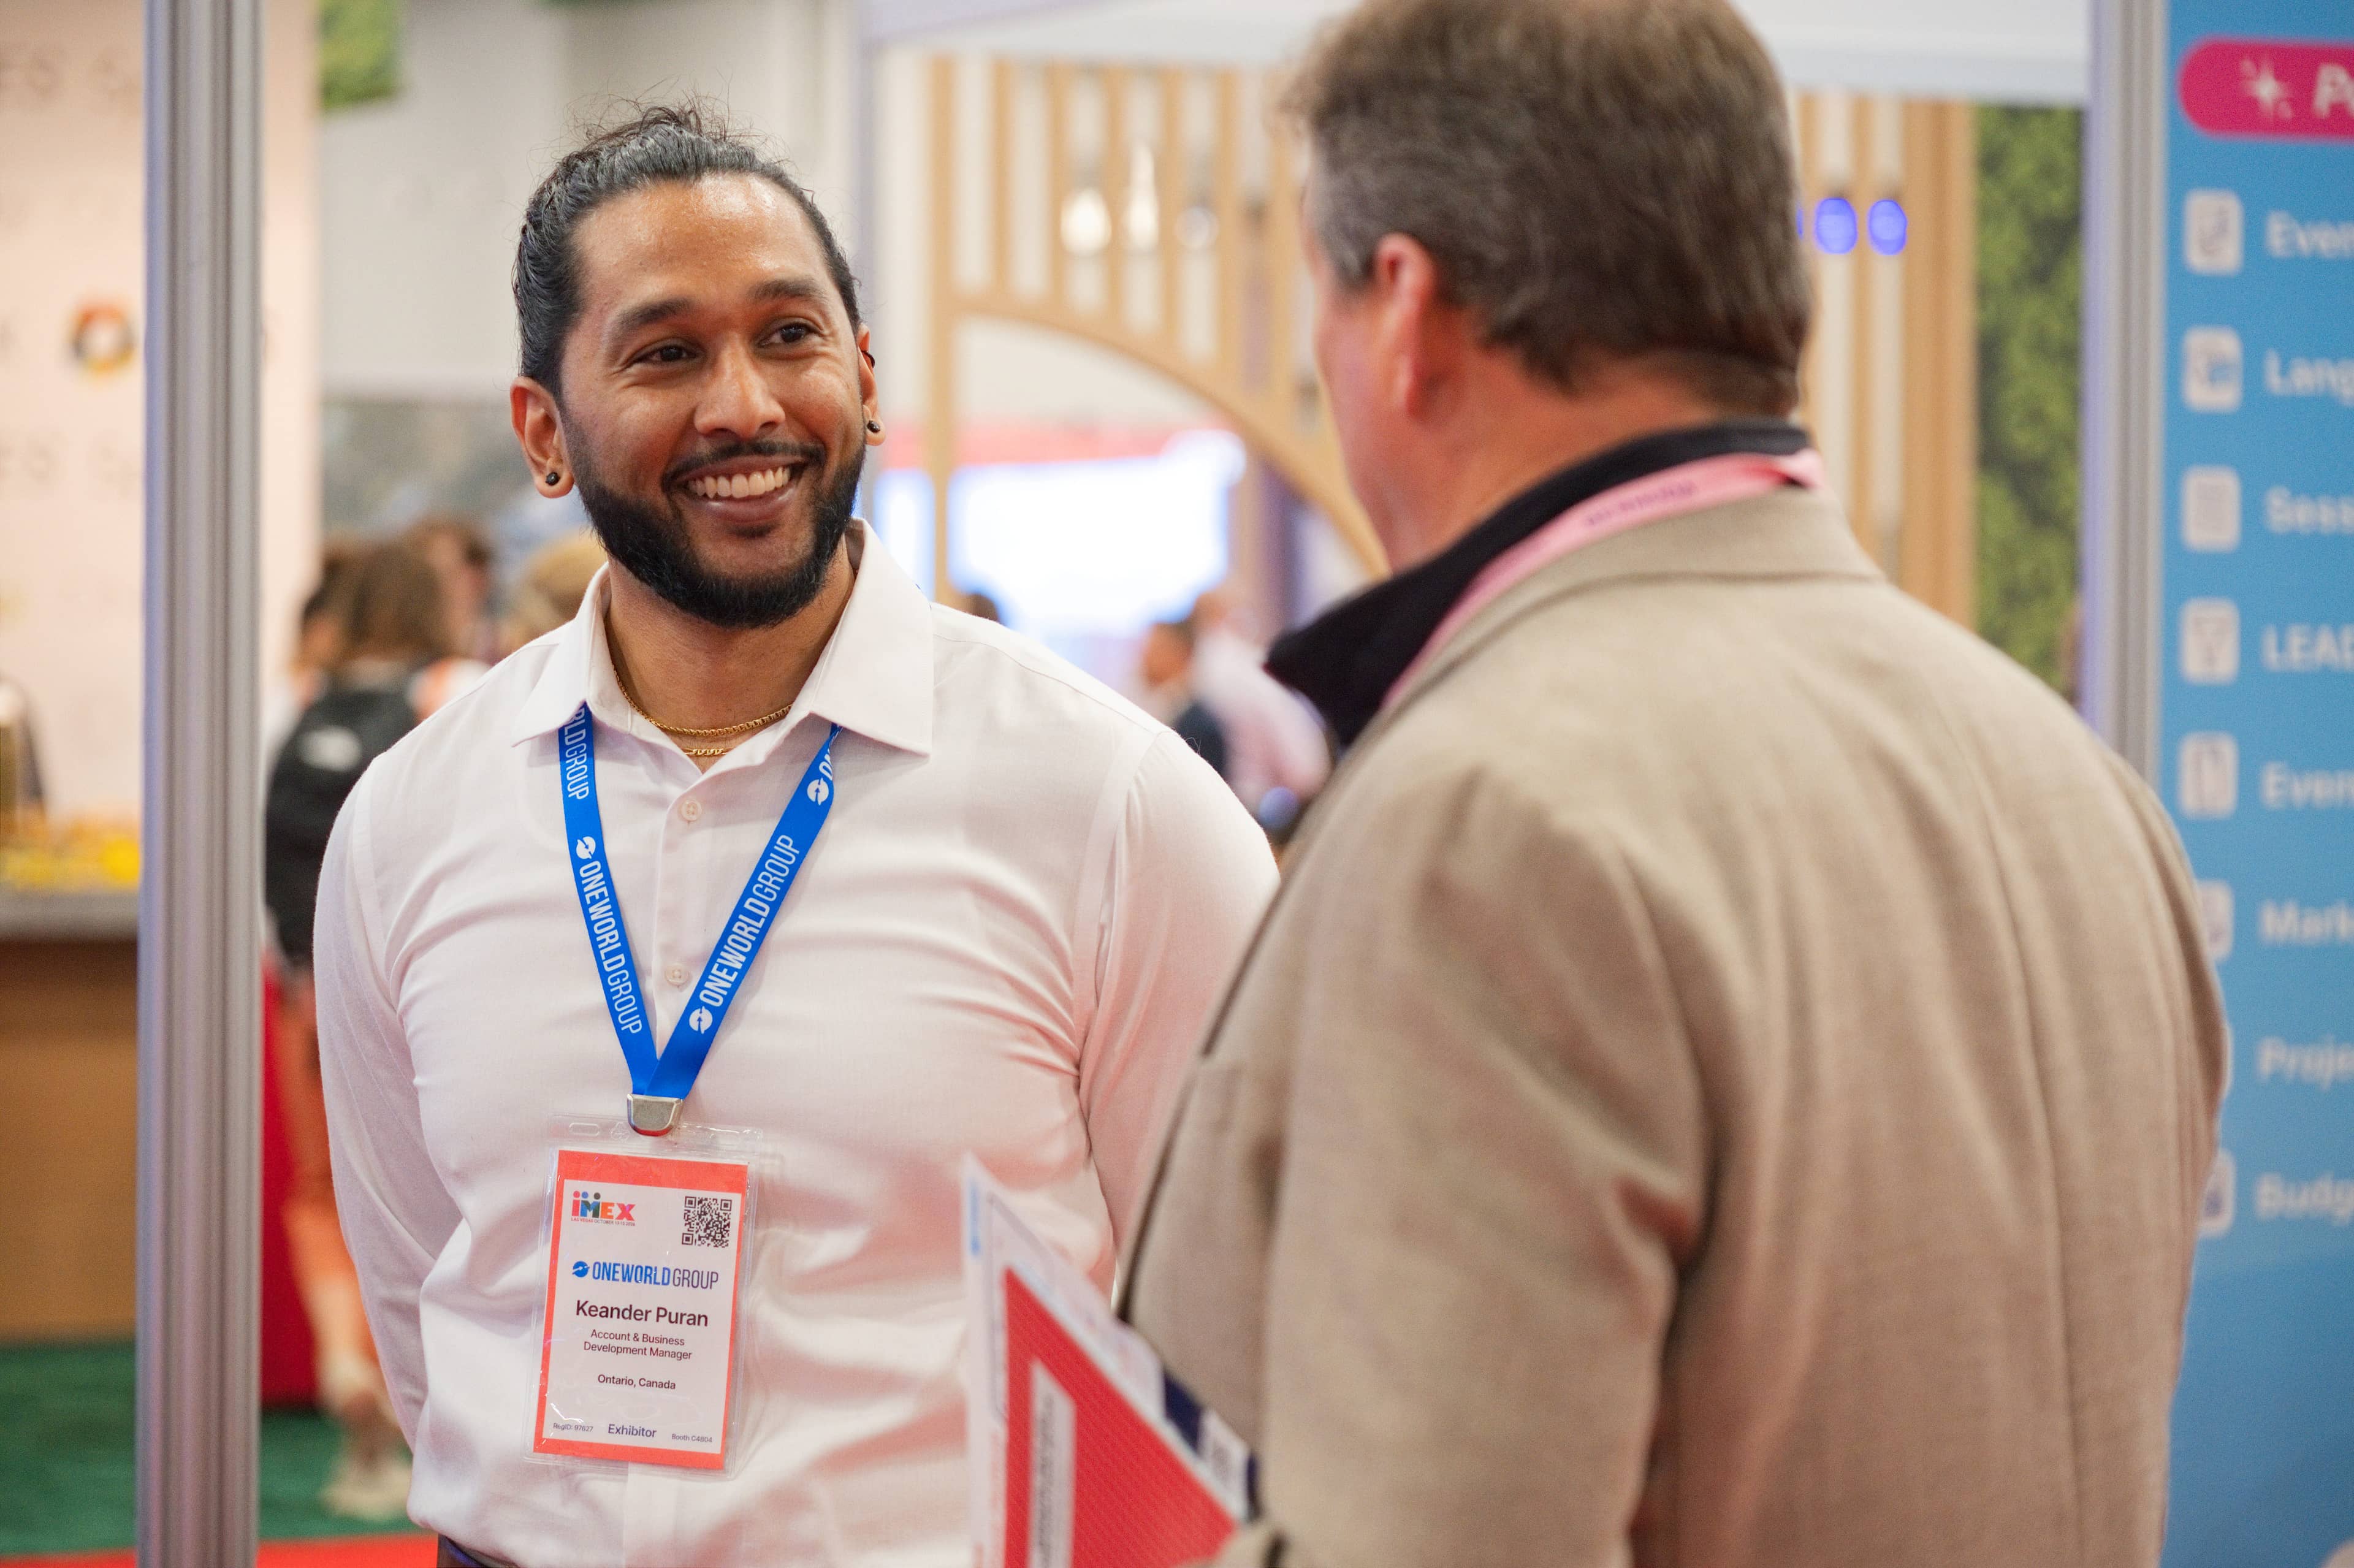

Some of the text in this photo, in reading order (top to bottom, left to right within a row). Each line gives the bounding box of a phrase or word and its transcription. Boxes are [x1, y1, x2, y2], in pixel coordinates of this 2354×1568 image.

[576, 1300, 709, 1327] Keander Puran
[590, 1329, 685, 1346] Account & Business
[584, 1341, 693, 1361] Development Manager
[598, 1374, 676, 1390] Ontario, Canada
[608, 1423, 657, 1437] Exhibitor
